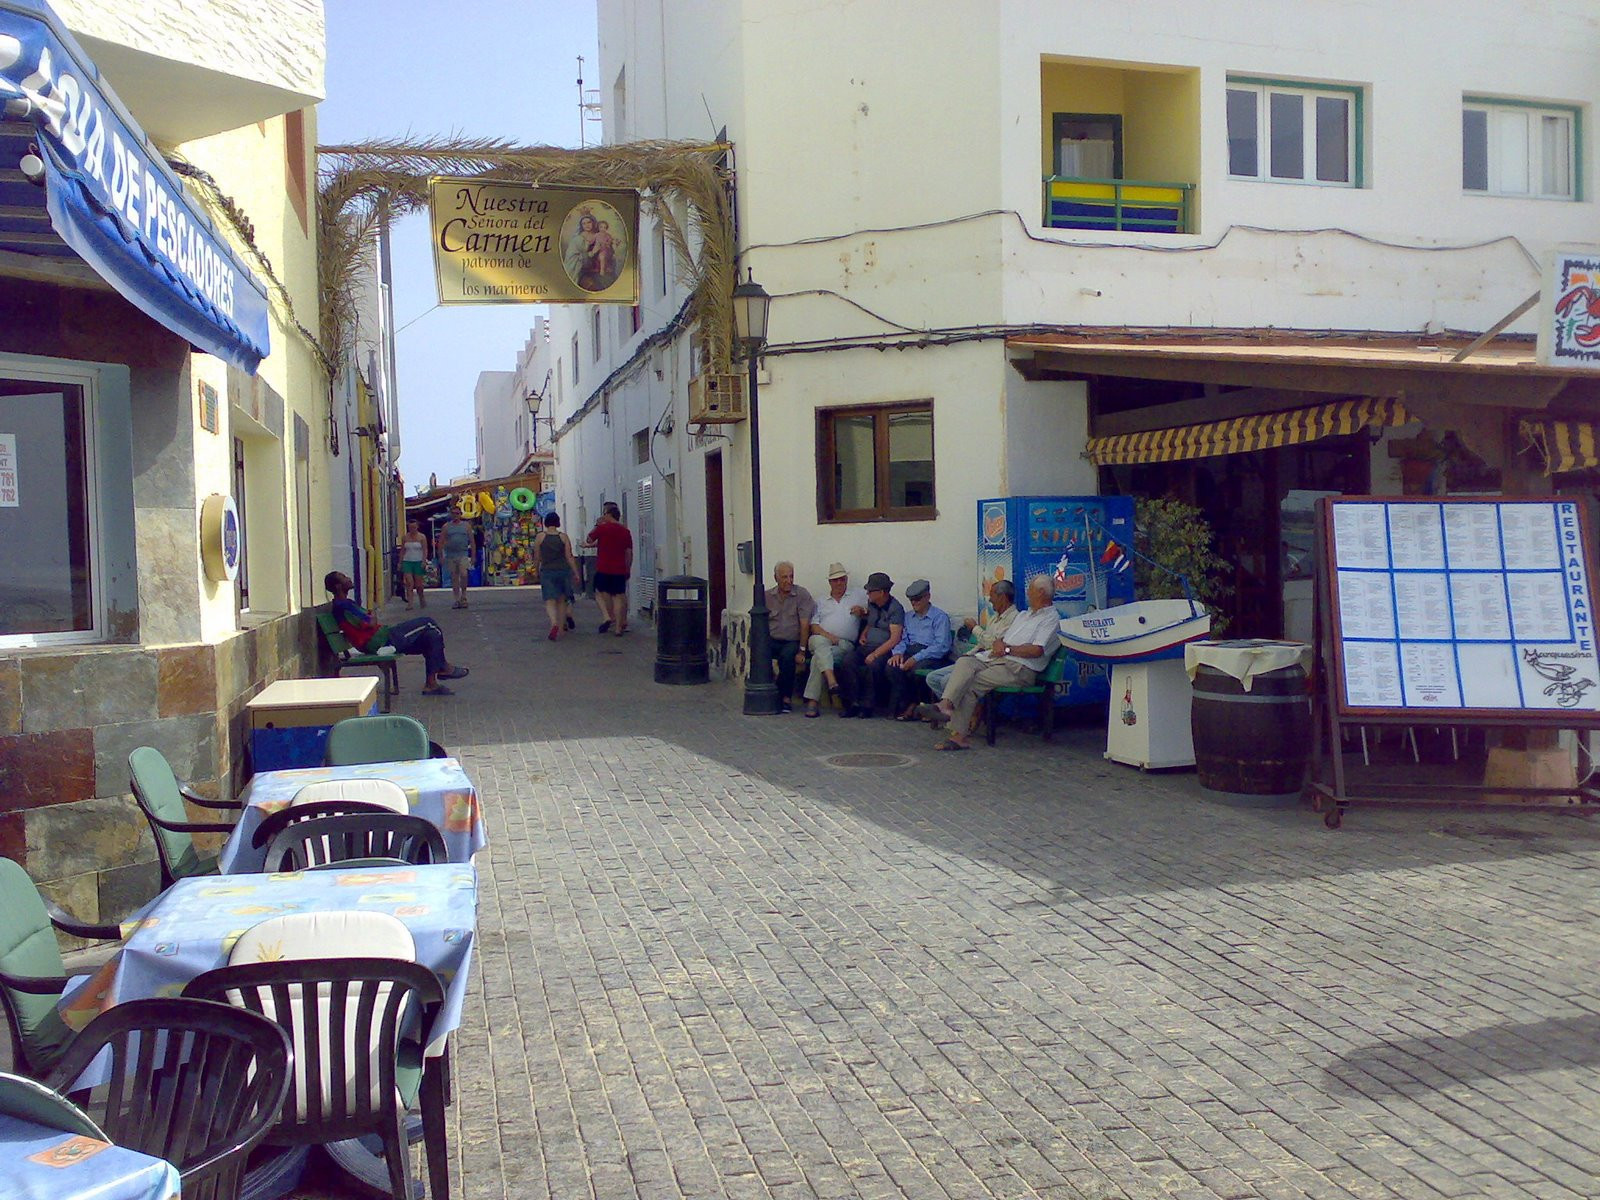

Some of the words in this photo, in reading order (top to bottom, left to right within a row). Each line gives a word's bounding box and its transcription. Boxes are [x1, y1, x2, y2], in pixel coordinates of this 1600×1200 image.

[456, 186, 549, 216] Nuestra
[111, 131, 140, 229] DE
[145, 170, 234, 320] PESCADORES
[467, 214, 519, 230] Señora
[524, 215, 545, 230] del
[440, 218, 552, 253] Carmen
[461, 255, 514, 273] patrona
[518, 254, 531, 269] de
[462, 277, 480, 296] los
[484, 282, 549, 296] marineros
[1560, 503, 1592, 652] RESTAURANTE
[1090, 627, 1110, 639] EVE
